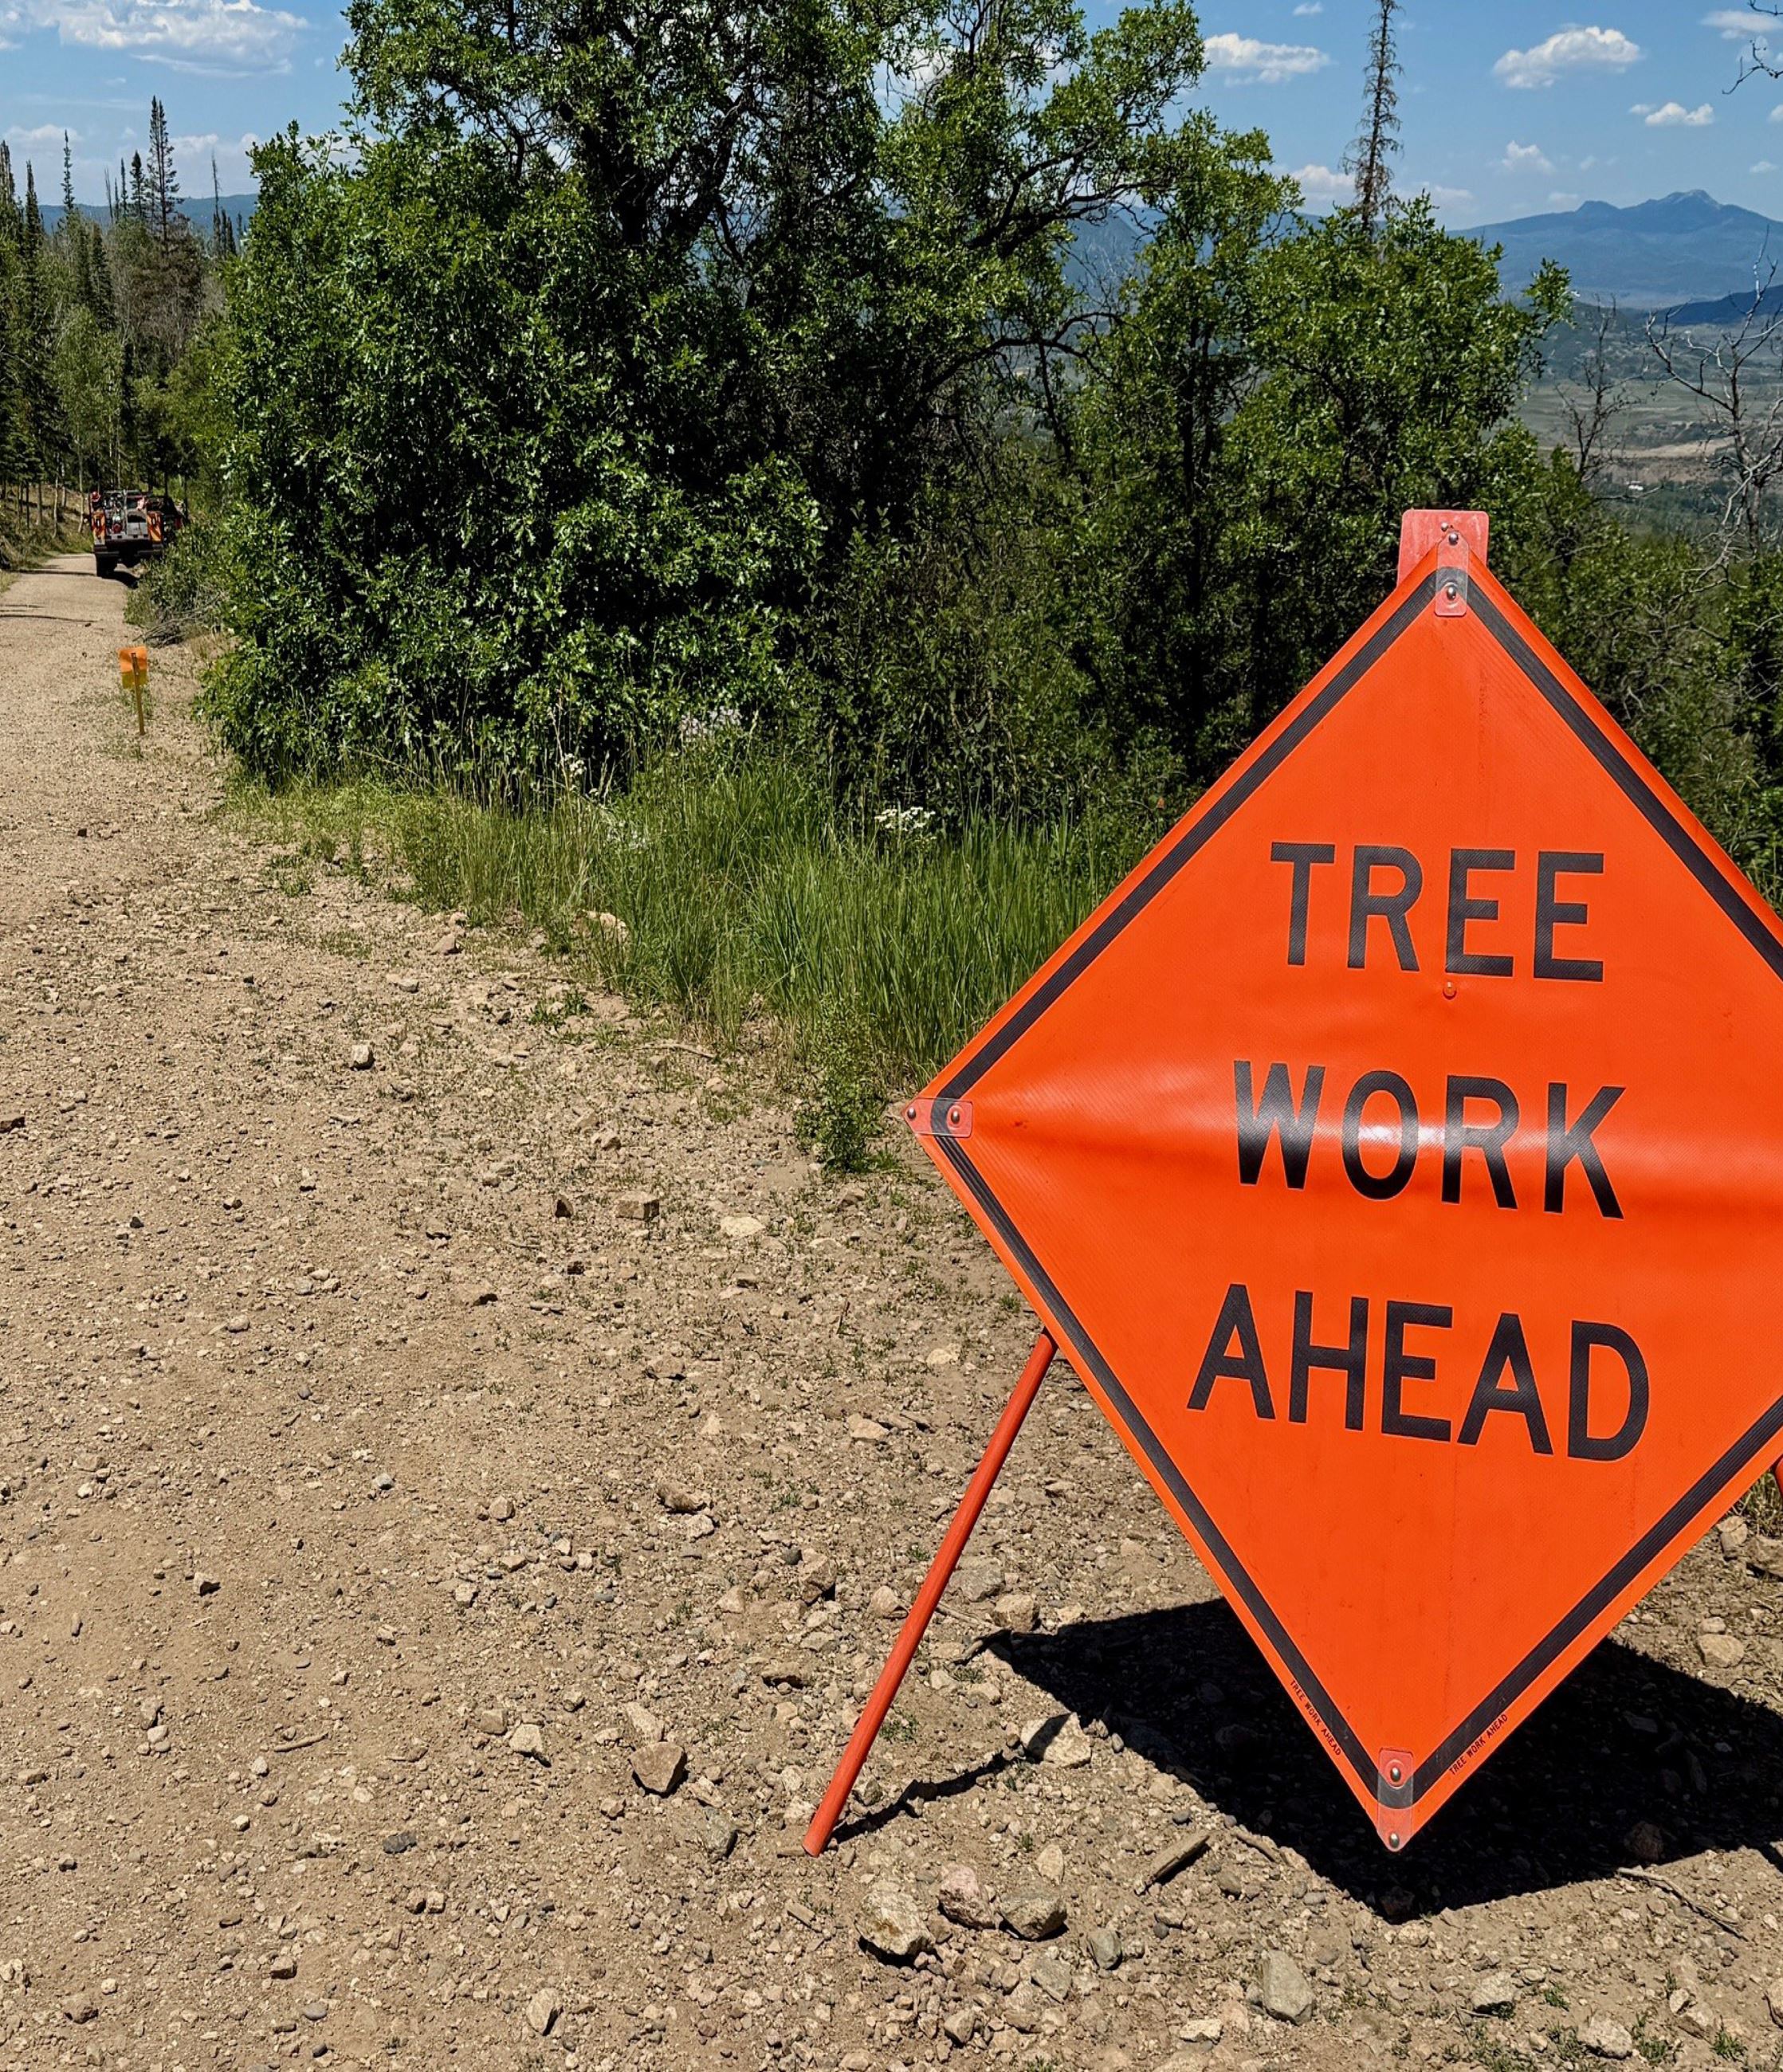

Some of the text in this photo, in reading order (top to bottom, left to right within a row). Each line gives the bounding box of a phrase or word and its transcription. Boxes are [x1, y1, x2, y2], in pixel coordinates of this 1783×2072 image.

[1270, 842, 1604, 982] TREE
[1234, 1060, 1626, 1219] WORK
[1187, 1283, 1650, 1463] AHEAD
[1290, 1679, 1341, 1756] TREE WORK AHEAD
[1449, 1713, 1508, 1776] TREE WORK AHEAD
